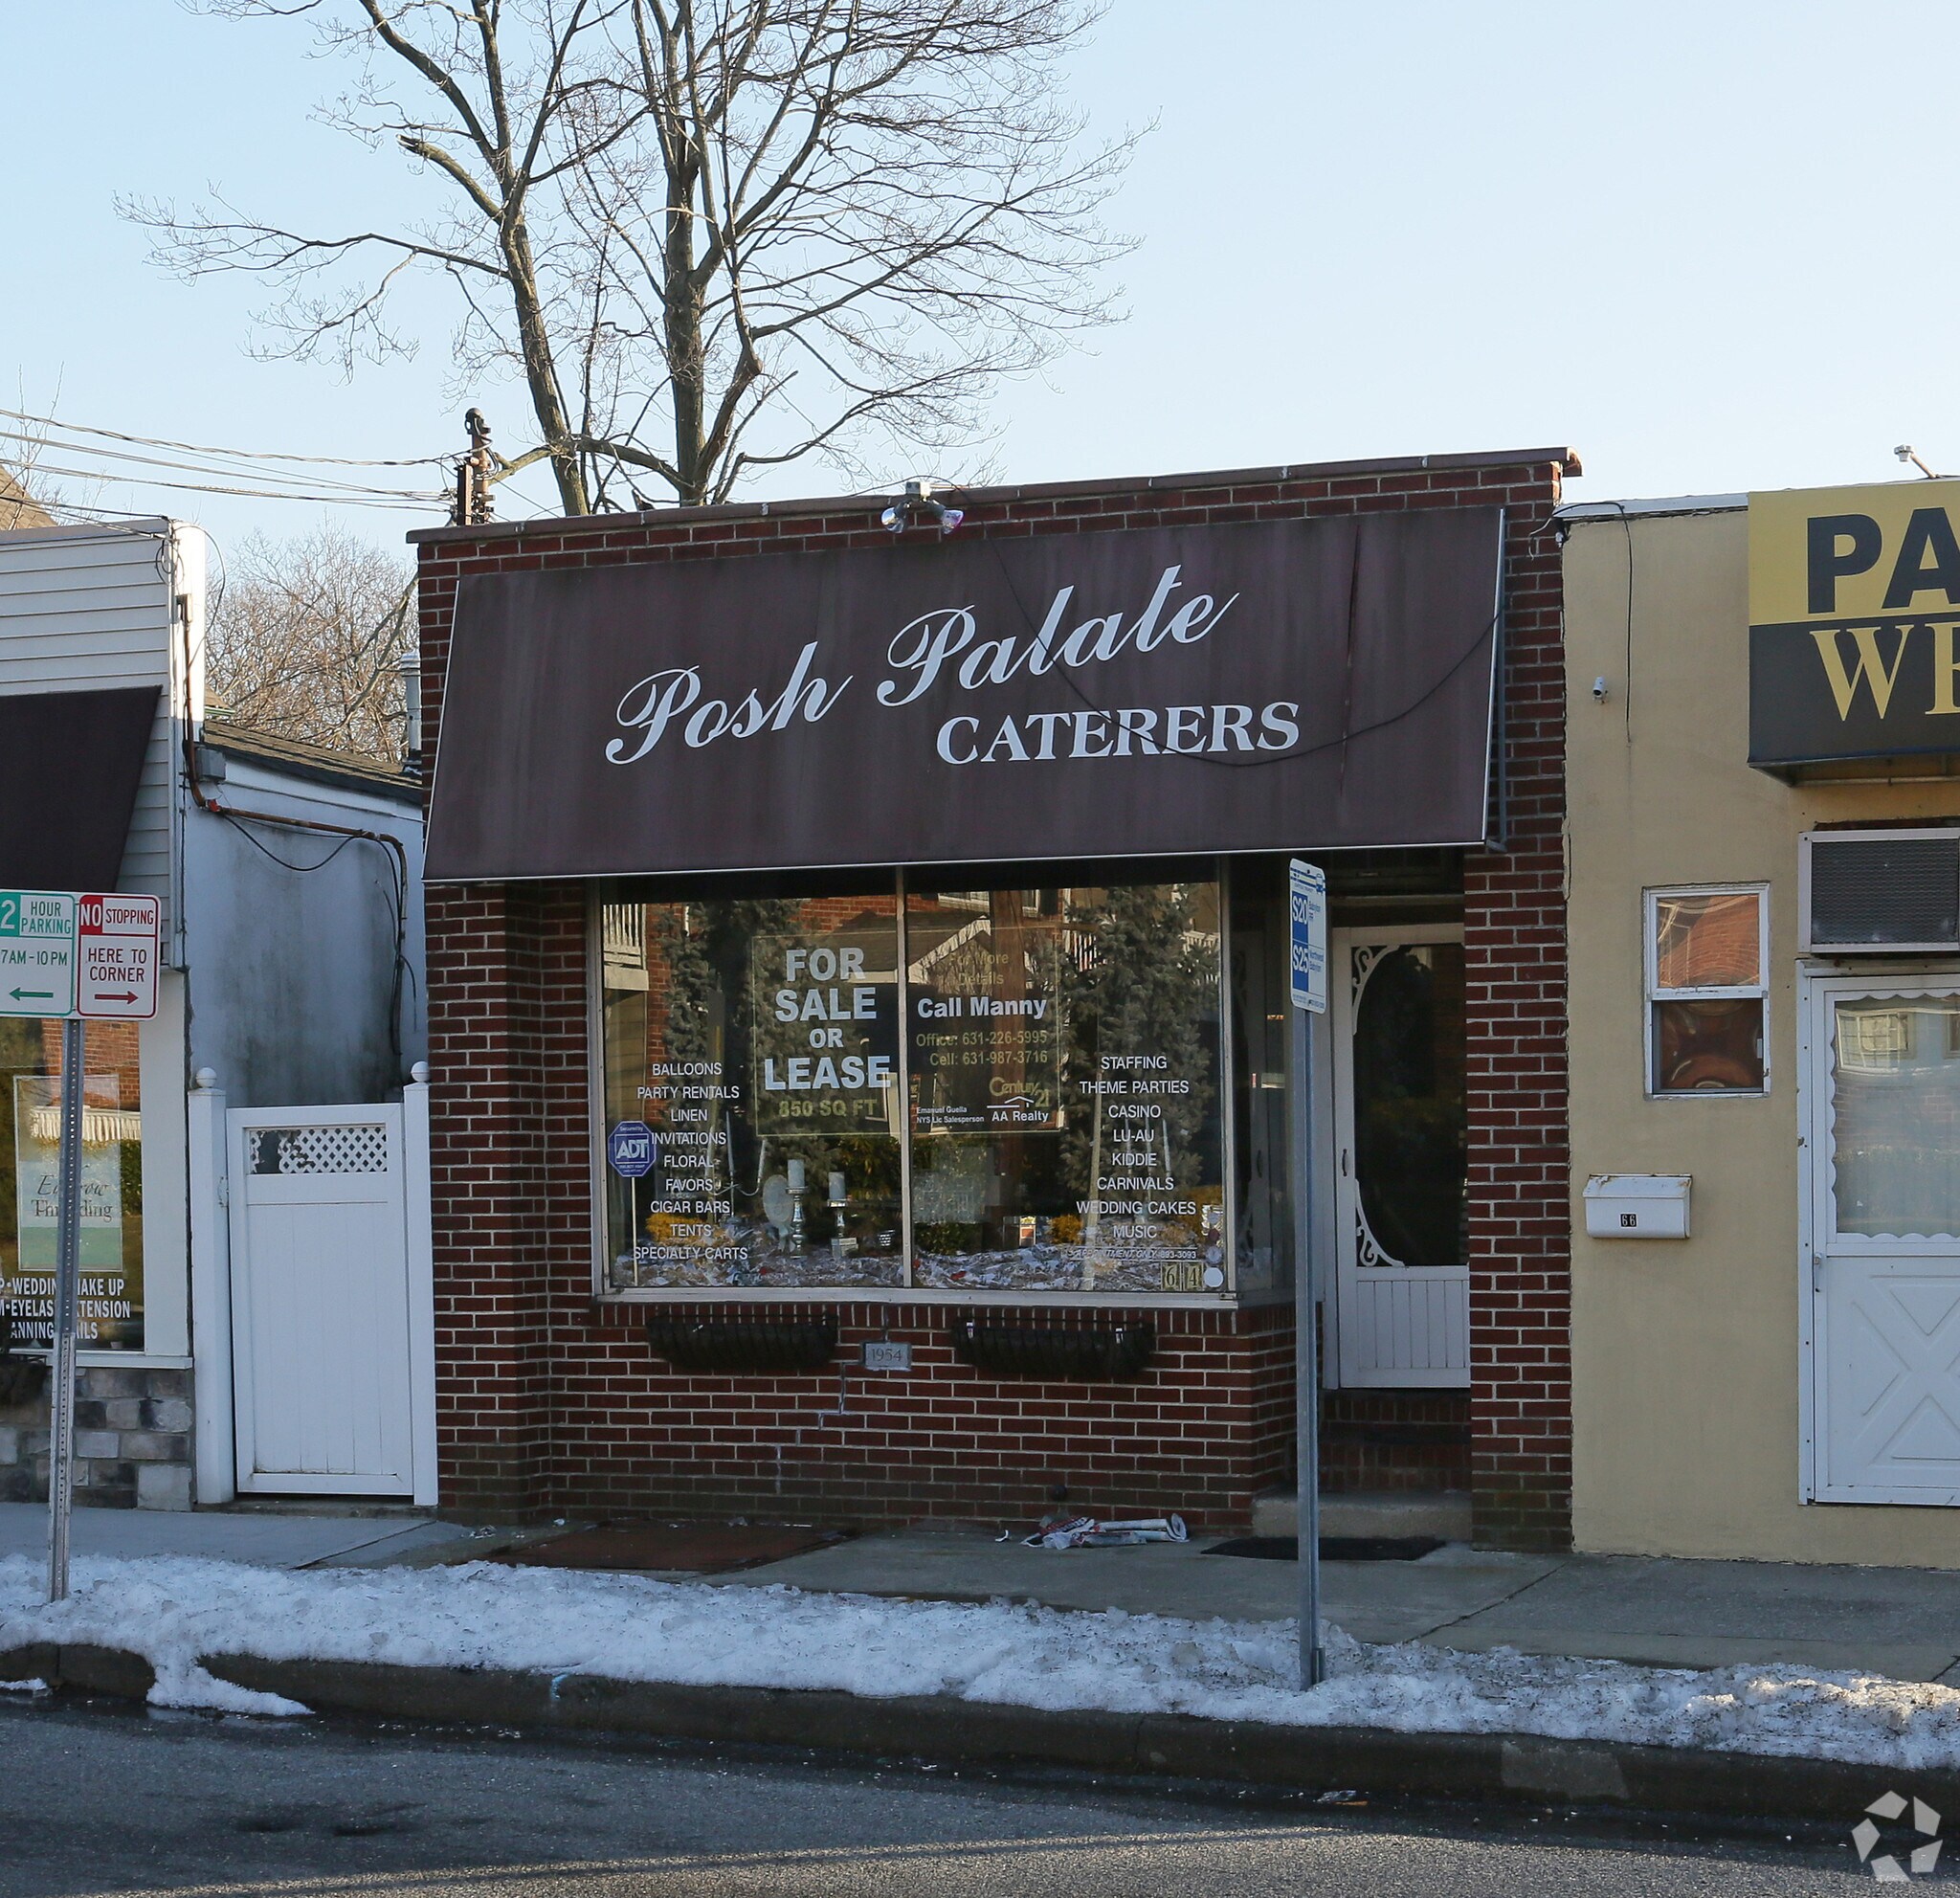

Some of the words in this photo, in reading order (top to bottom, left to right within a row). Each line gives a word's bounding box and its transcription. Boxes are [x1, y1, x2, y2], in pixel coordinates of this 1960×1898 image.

[605, 641, 853, 765] Posh
[878, 564, 1238, 706] Palate
[937, 702, 1300, 765] CATERERS
[1, 899, 16, 929] 2
[31, 901, 61, 917] HOUR
[80, 904, 101, 927] NO
[105, 908, 154, 925] STOPPING
[1293, 895, 1308, 925] S20
[21, 918, 71, 934] PARKING
[88, 948, 123, 964] HERE
[131, 949, 146, 964] TO
[1293, 944, 1308, 973] S25
[786, 948, 866, 982] FOR
[90, 966, 145, 982] CORNER
[775, 987, 877, 1022] SALE
[918, 997, 962, 1018] Call
[969, 996, 1047, 1019] Manny
[809, 1028, 844, 1049] OR
[916, 1033, 958, 1046] Office:
[962, 1030, 1048, 1045] 631-226-5995
[929, 1052, 958, 1066] Cell:
[962, 1050, 1048, 1064] 631-987-3716
[1101, 1056, 1168, 1069] STAFFING
[653, 1062, 723, 1076] BALLOONS
[765, 1056, 892, 1090] LEASE
[637, 1086, 679, 1099] PARTY
[683, 1085, 740, 1099] RENTALS
[990, 1077, 1039, 1096] Century
[1080, 1081, 1127, 1094] THEME
[1132, 1080, 1190, 1093] PARTIES
[1036, 1089, 1050, 1107] 21
[671, 1108, 708, 1122] LINEN
[779, 1101, 813, 1118] 850
[819, 1100, 847, 1118] SQ
[853, 1099, 878, 1117] FT
[991, 1110, 1009, 1122] AA
[1013, 1109, 1049, 1123] Realty
[1108, 1105, 1161, 1118] CASINO
[944, 1115, 985, 1125] Salesperson
[651, 1132, 727, 1145] INVITATIONS
[1113, 1128, 1154, 1142] LU-AU
[615, 1139, 649, 1159] ADT
[664, 1154, 714, 1168] FLORAL
[1112, 1152, 1157, 1166] KIDDIE
[665, 1178, 714, 1192] FAVORS
[1097, 1176, 1174, 1191] CARNIVALS
[650, 1200, 691, 1214] CIGAR
[695, 1200, 731, 1214] BARS
[1076, 1200, 1144, 1214] WEDDING
[1147, 1201, 1197, 1215] CAKES
[1621, 1214, 1636, 1227] 66
[670, 1223, 712, 1237] TENTS
[1113, 1225, 1157, 1239] MUSIC
[633, 1246, 701, 1260] SPECIALTY
[704, 1246, 748, 1260] CARTS
[108, 1279, 124, 1296] UP
[872, 1348, 902, 1362] 1954
